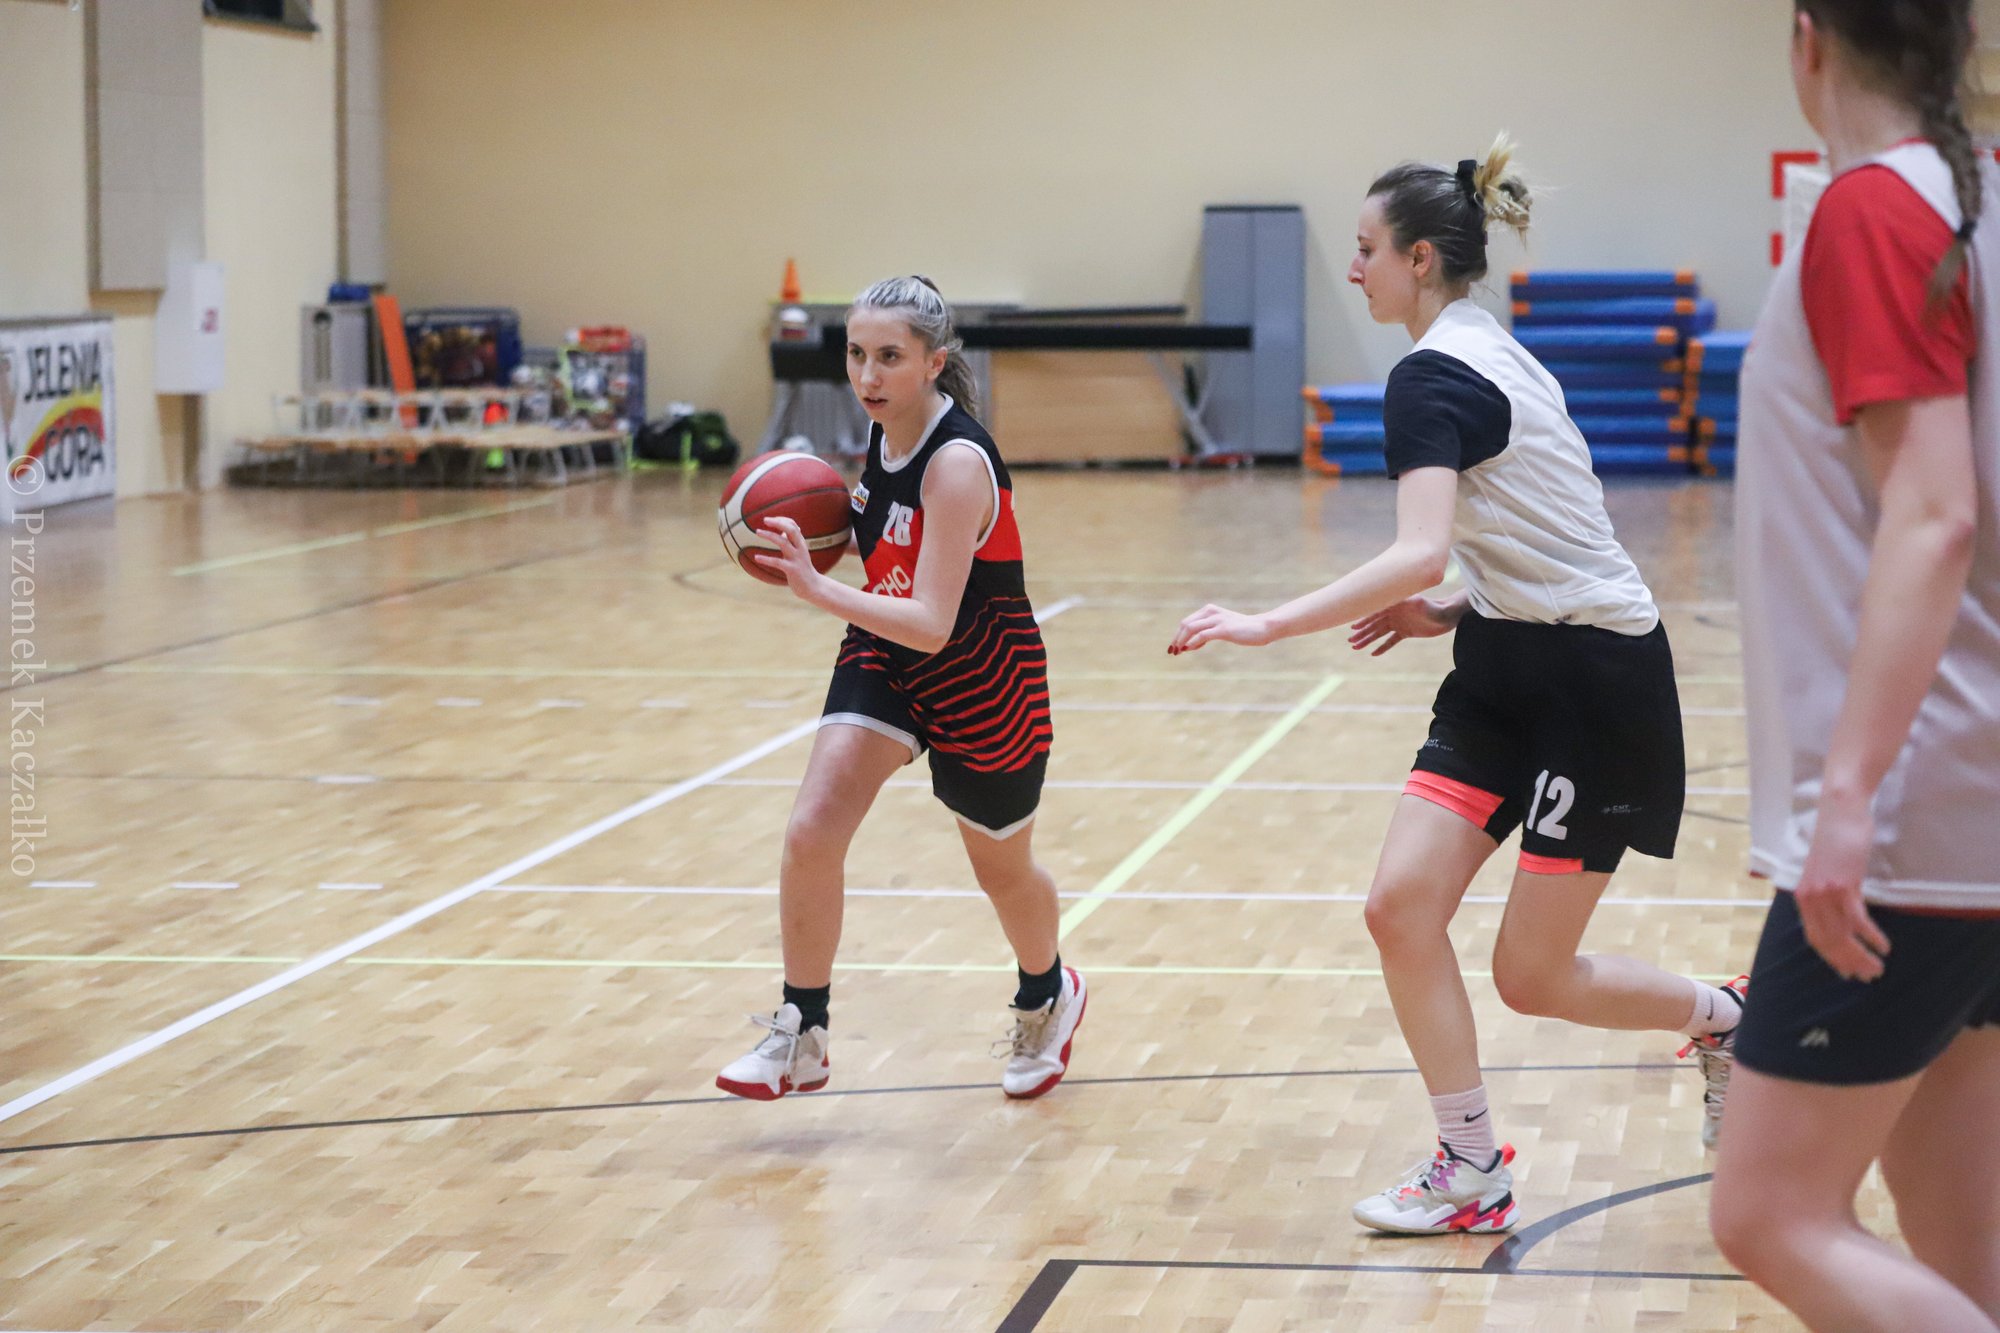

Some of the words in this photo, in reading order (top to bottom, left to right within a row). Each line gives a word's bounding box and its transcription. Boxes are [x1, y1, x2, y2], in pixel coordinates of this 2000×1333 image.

[24, 341, 101, 402] JELENIA
[882, 501, 914, 547] 26
[1526, 769, 1575, 840] 12
